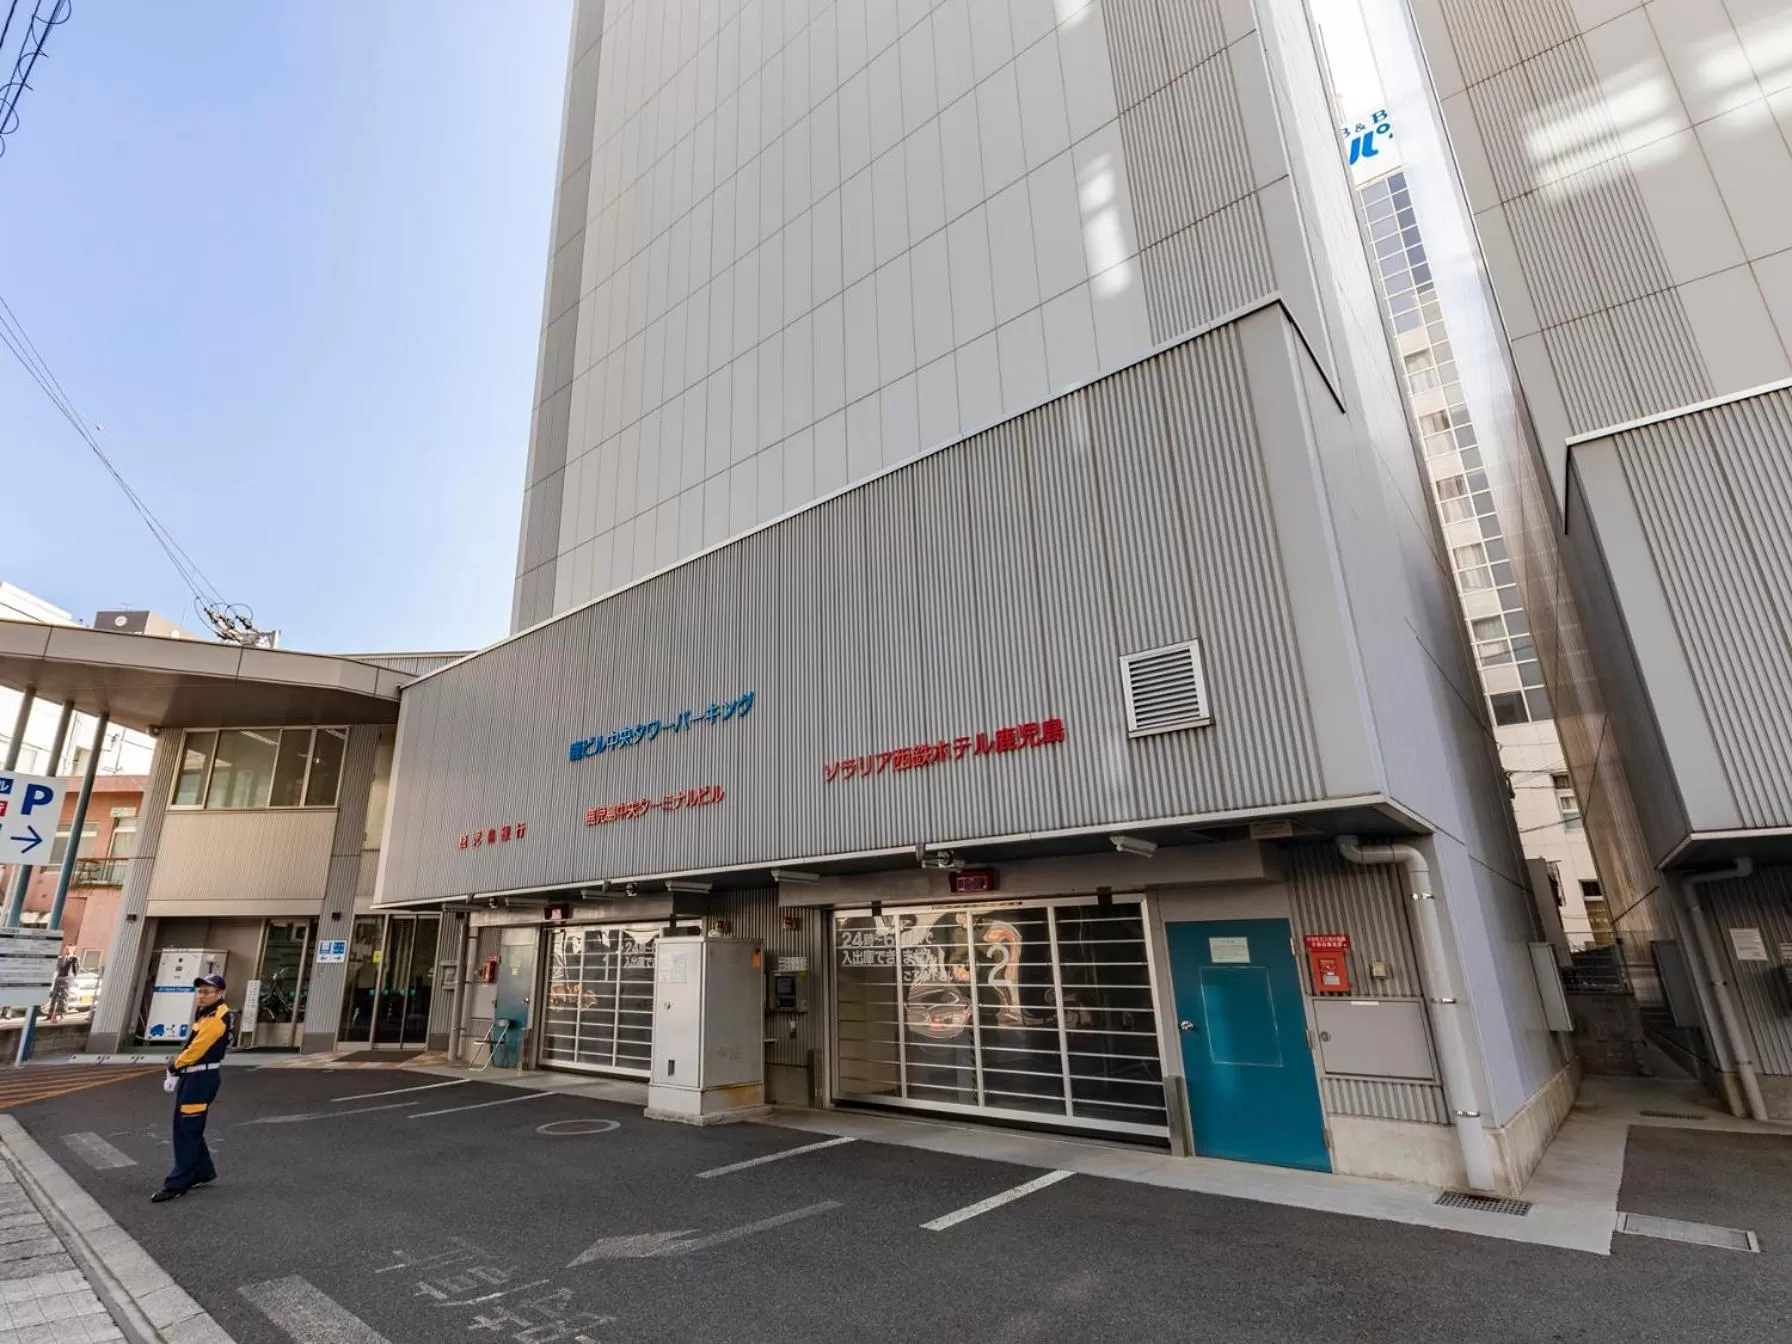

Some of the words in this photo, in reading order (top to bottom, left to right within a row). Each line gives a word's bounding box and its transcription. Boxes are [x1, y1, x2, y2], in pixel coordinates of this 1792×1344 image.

[1371, 109, 1388, 124] B
[824, 716, 1065, 783] ソラリア西鉄ホテル鹿児島
[21, 783, 54, 815] P
[986, 942, 1011, 986] 2
